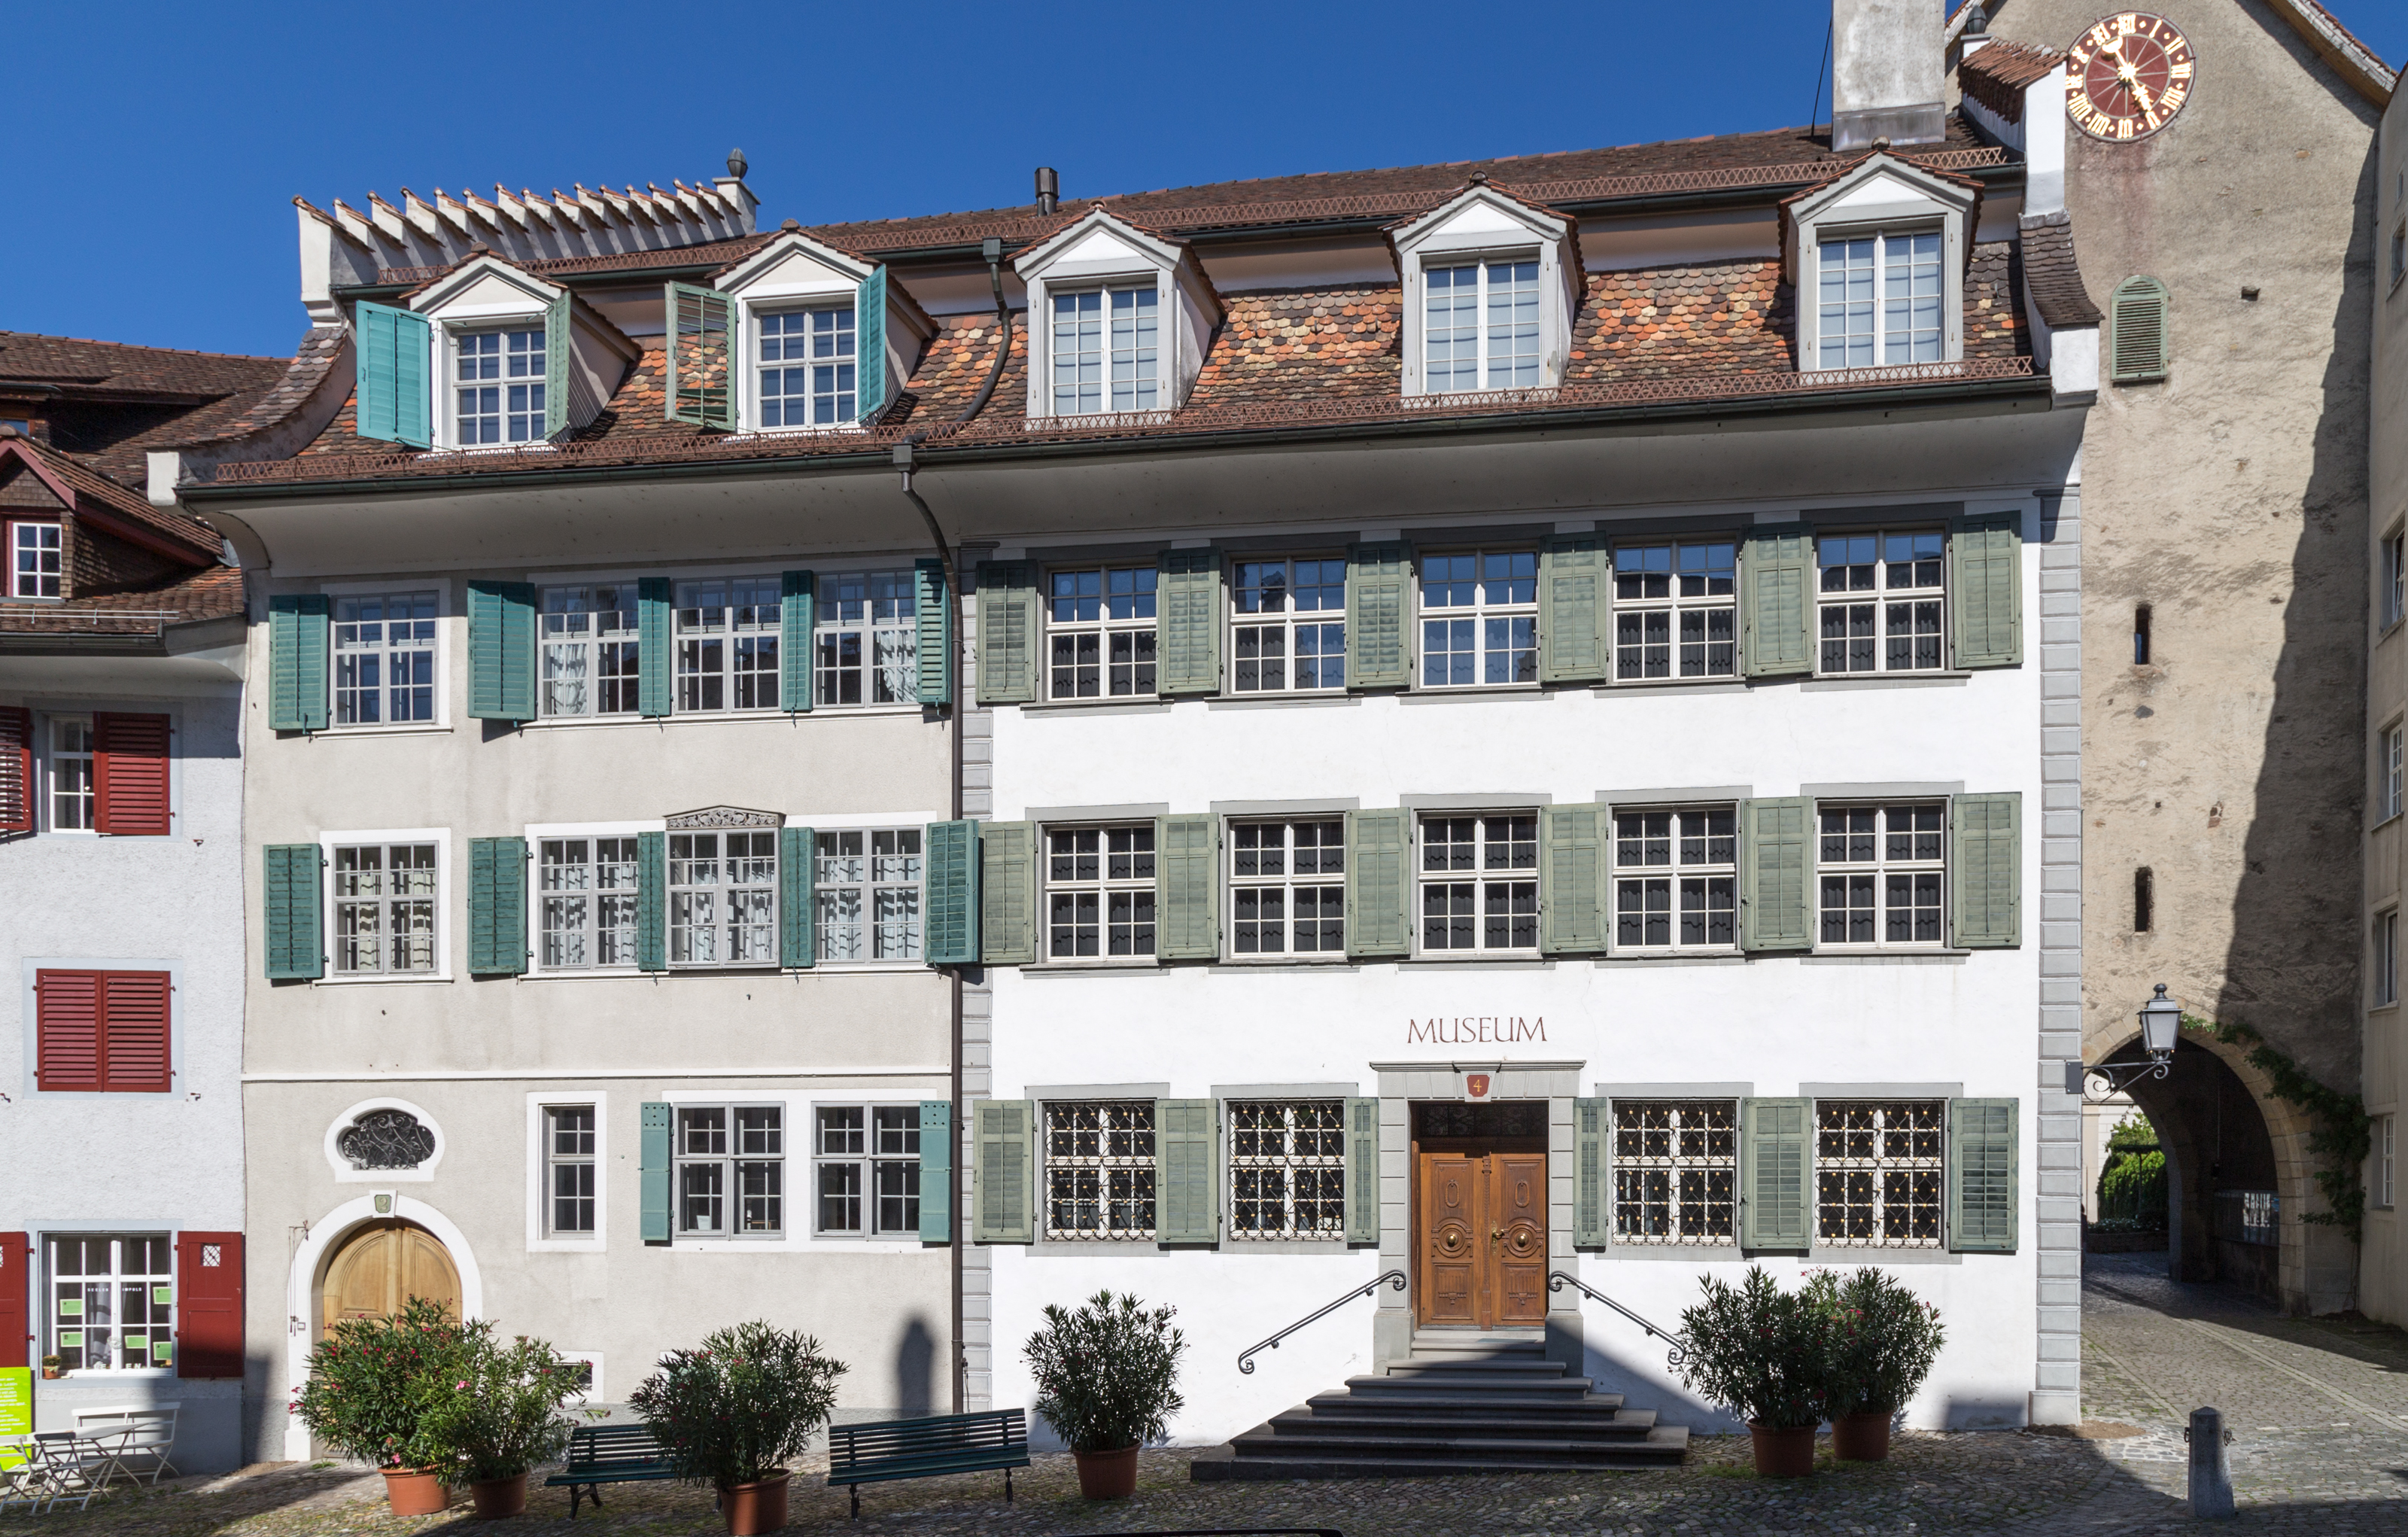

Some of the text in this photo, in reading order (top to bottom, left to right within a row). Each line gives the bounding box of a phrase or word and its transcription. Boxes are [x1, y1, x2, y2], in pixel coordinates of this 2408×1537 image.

[2117, 14, 2136, 35] XII
[2148, 19, 2163, 38] I
[2090, 23, 2111, 46] XI
[2072, 45, 2090, 64] X
[2164, 36, 2185, 55] II
[2170, 62, 2191, 79] III
[1406, 1016, 1548, 1044] MUSEUM
[1473, 1079, 1482, 1092] 4
[379, 1197, 388, 1211] 2
